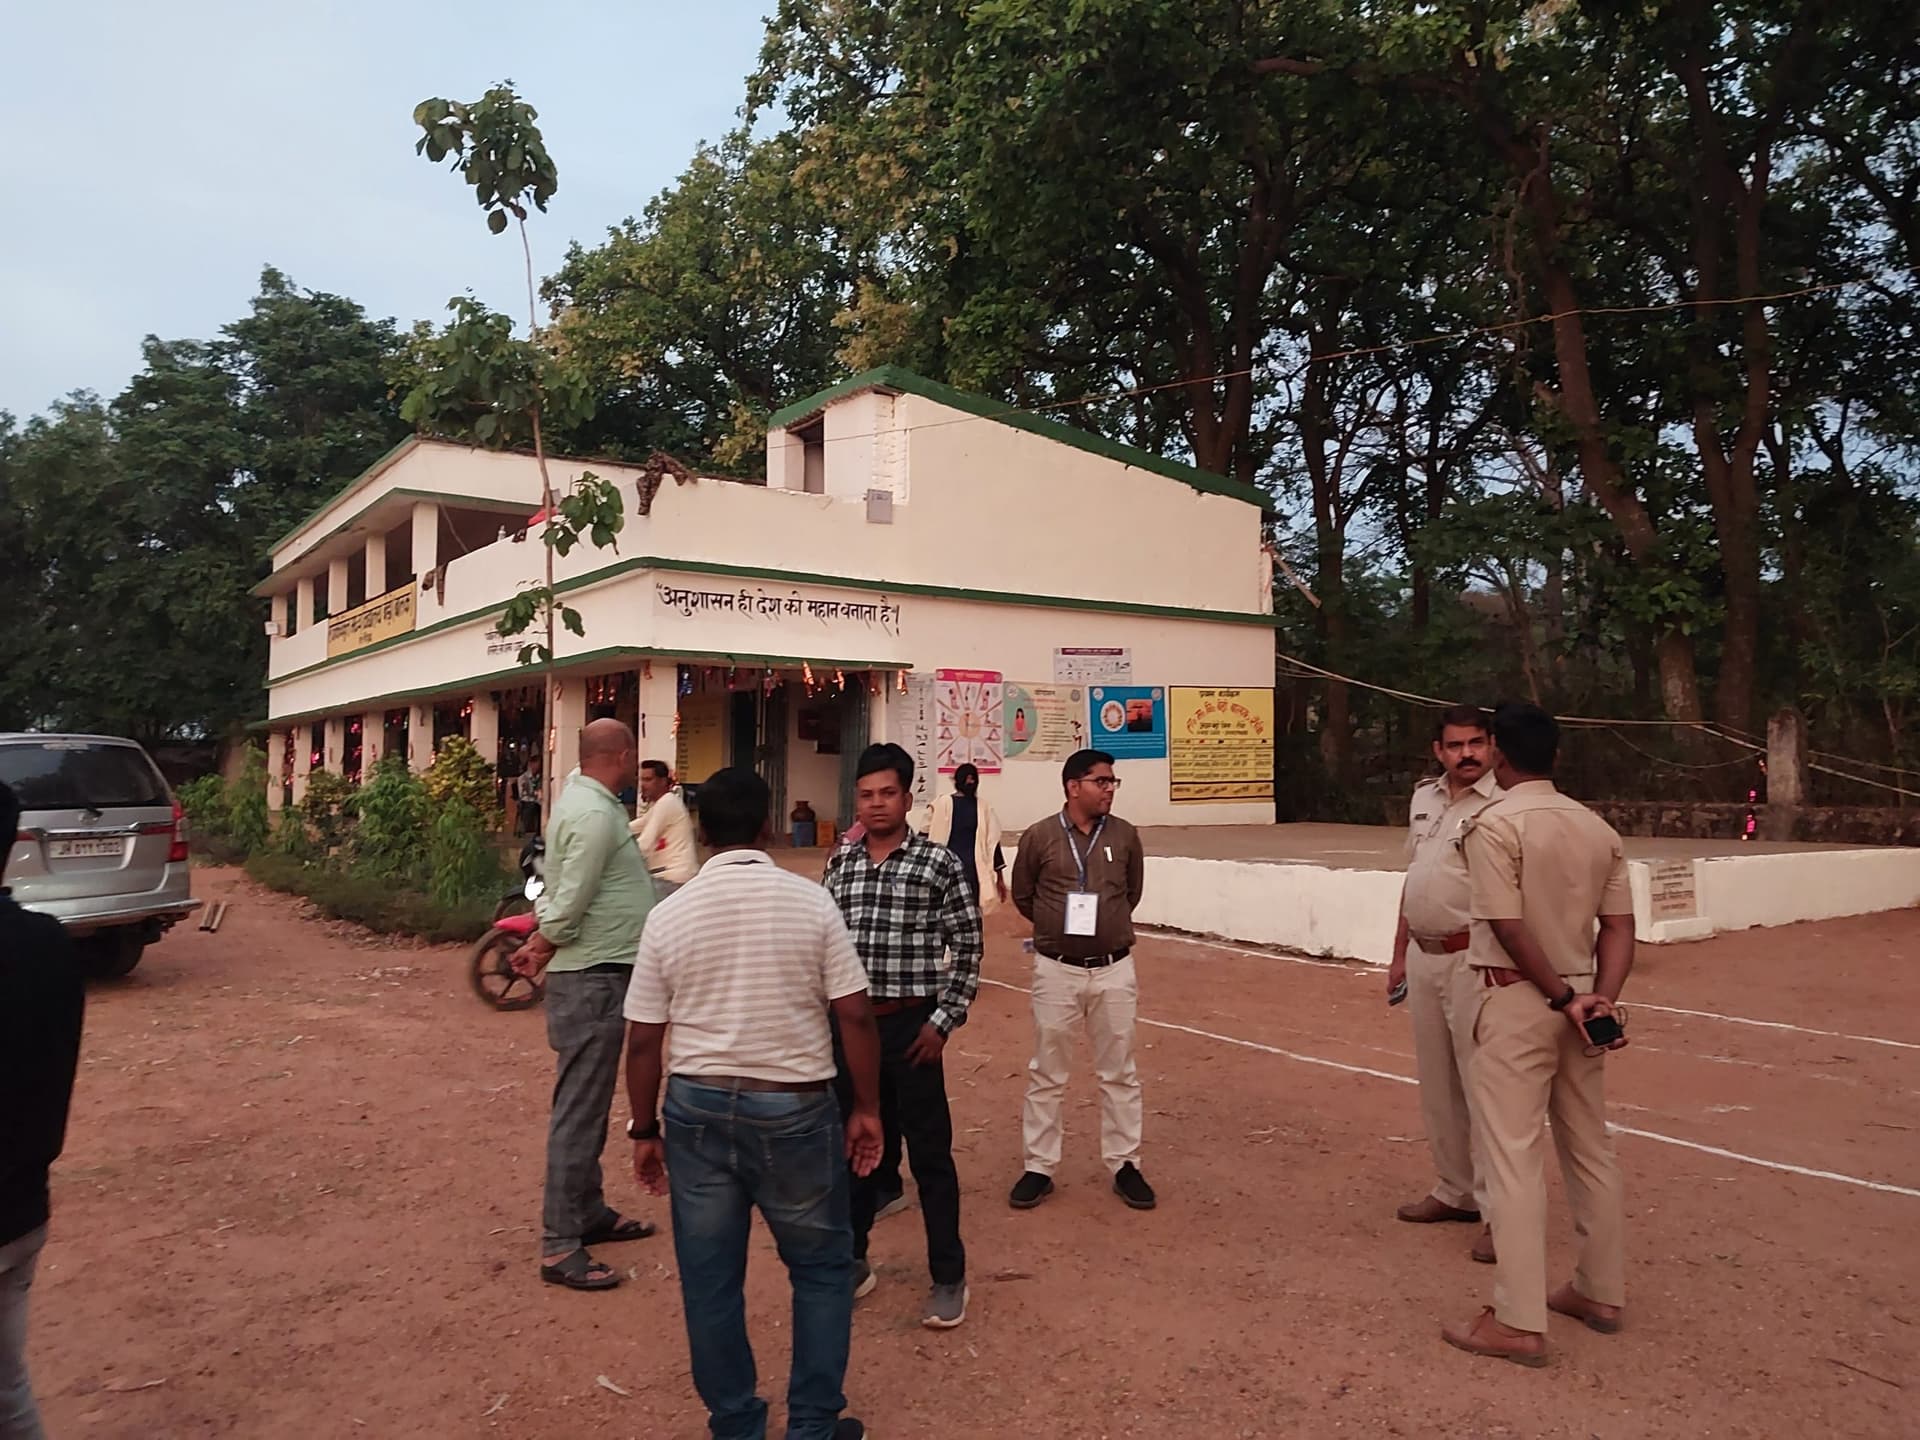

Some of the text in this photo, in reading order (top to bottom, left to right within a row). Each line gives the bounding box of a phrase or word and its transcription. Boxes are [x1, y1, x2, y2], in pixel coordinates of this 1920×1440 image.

[738, 589, 754, 619] ही
[757, 587, 782, 619] देश
[783, 590, 804, 616] को
[806, 599, 841, 624] महान
